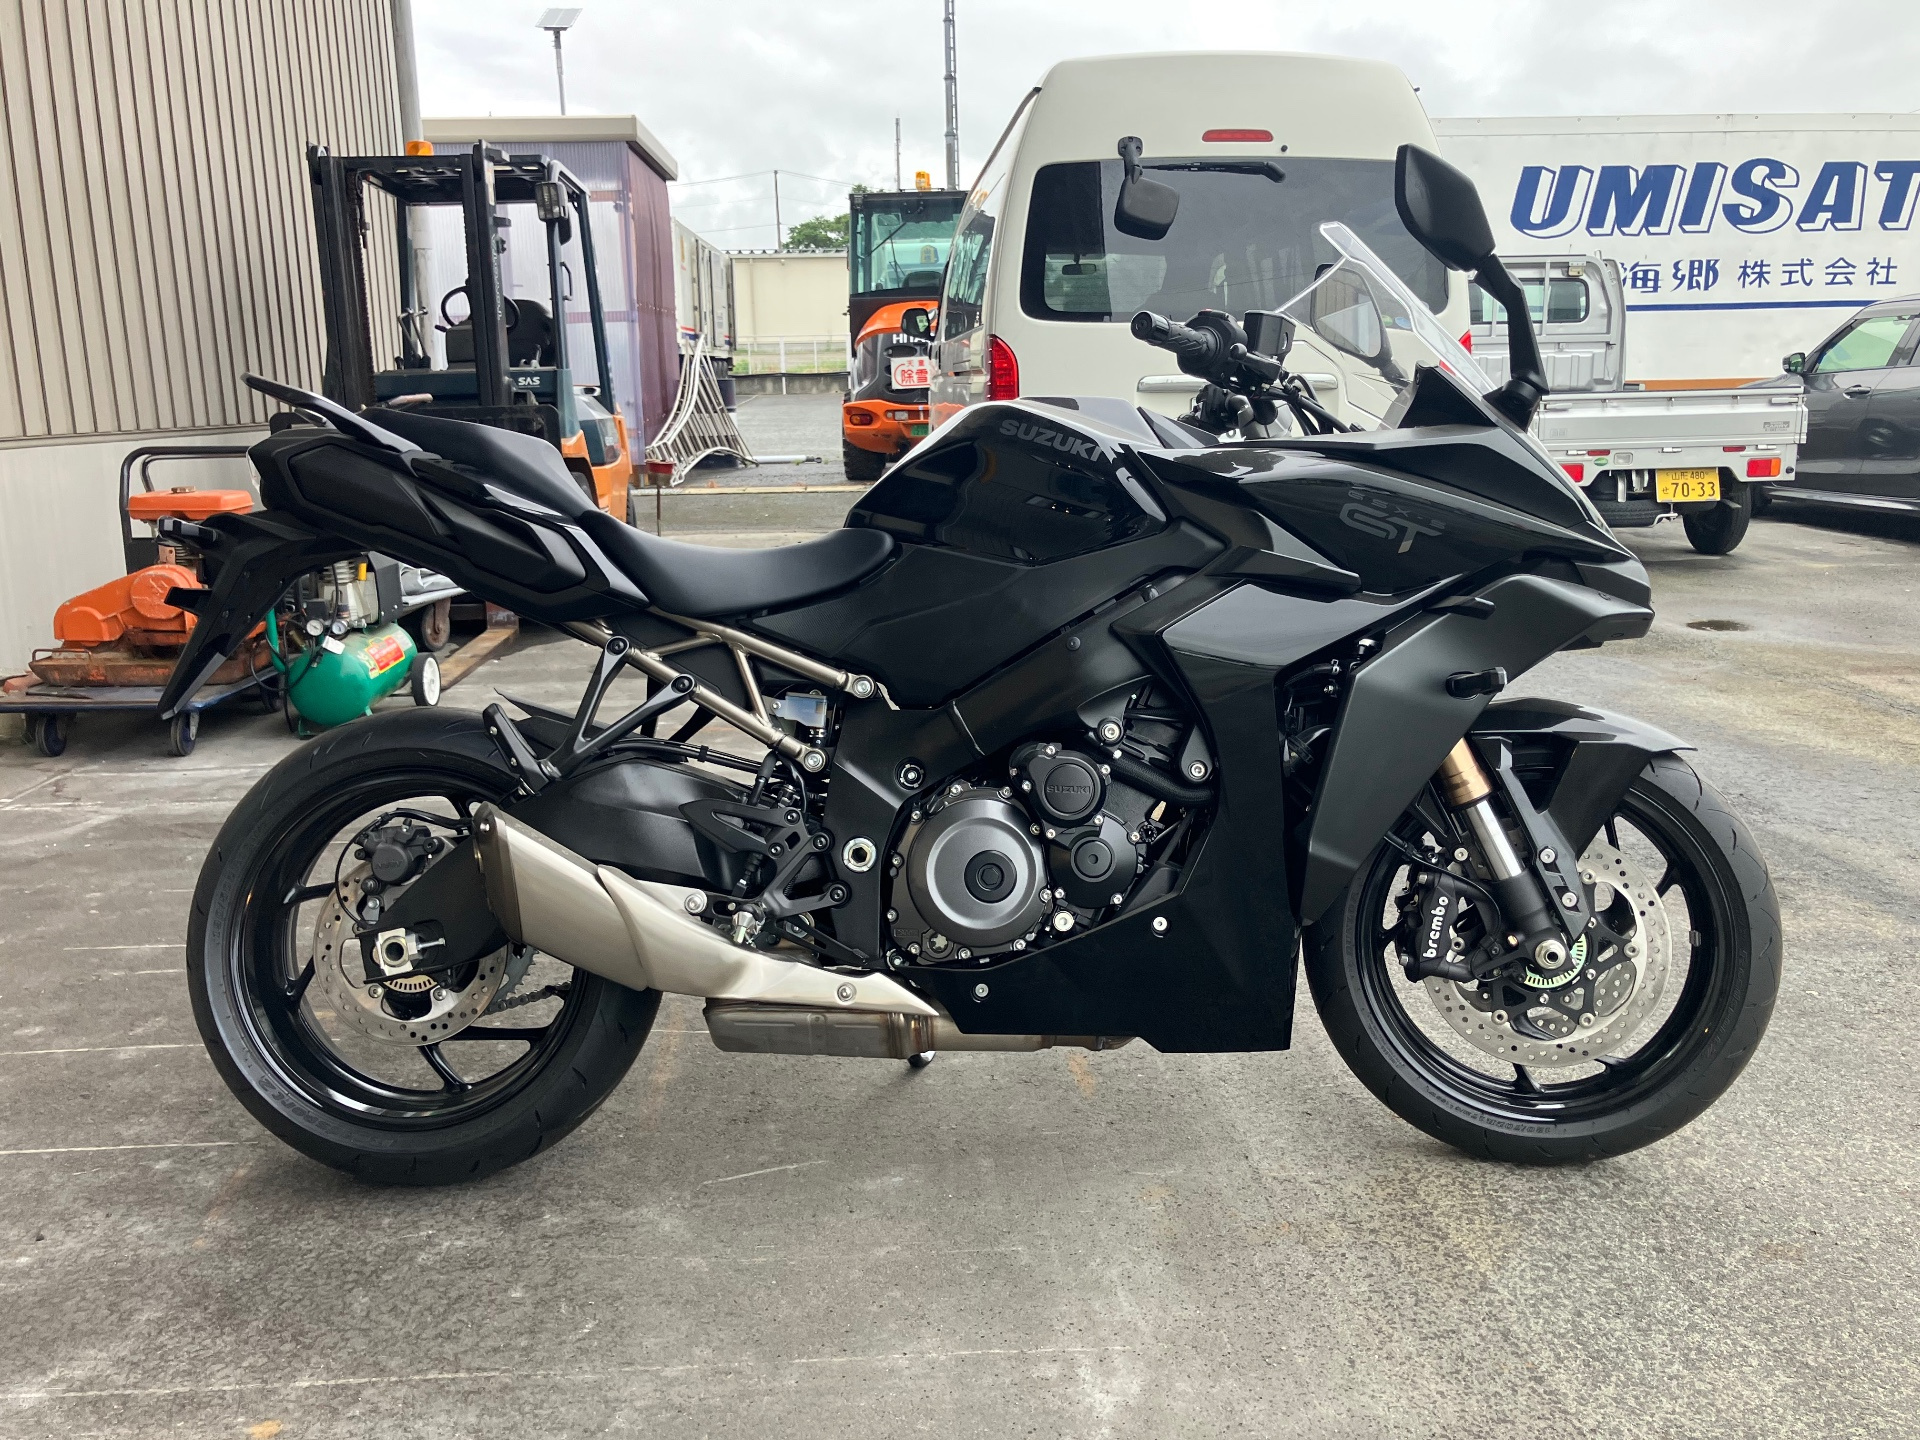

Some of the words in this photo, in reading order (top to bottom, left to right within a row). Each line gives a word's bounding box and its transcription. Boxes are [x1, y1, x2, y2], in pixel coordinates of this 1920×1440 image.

[1510, 157, 1920, 240] UMISAT
[1737, 256, 1898, 289] 株式会社
[518, 376, 541, 386] SAS
[901, 368, 929, 384] 除雪
[999, 419, 1103, 462] SUZUKI
[1689, 471, 1705, 480] 480
[1671, 481, 1716, 498] 70-33
[1046, 784, 1091, 795] SUZUKI
[1422, 896, 1449, 958] brembo
